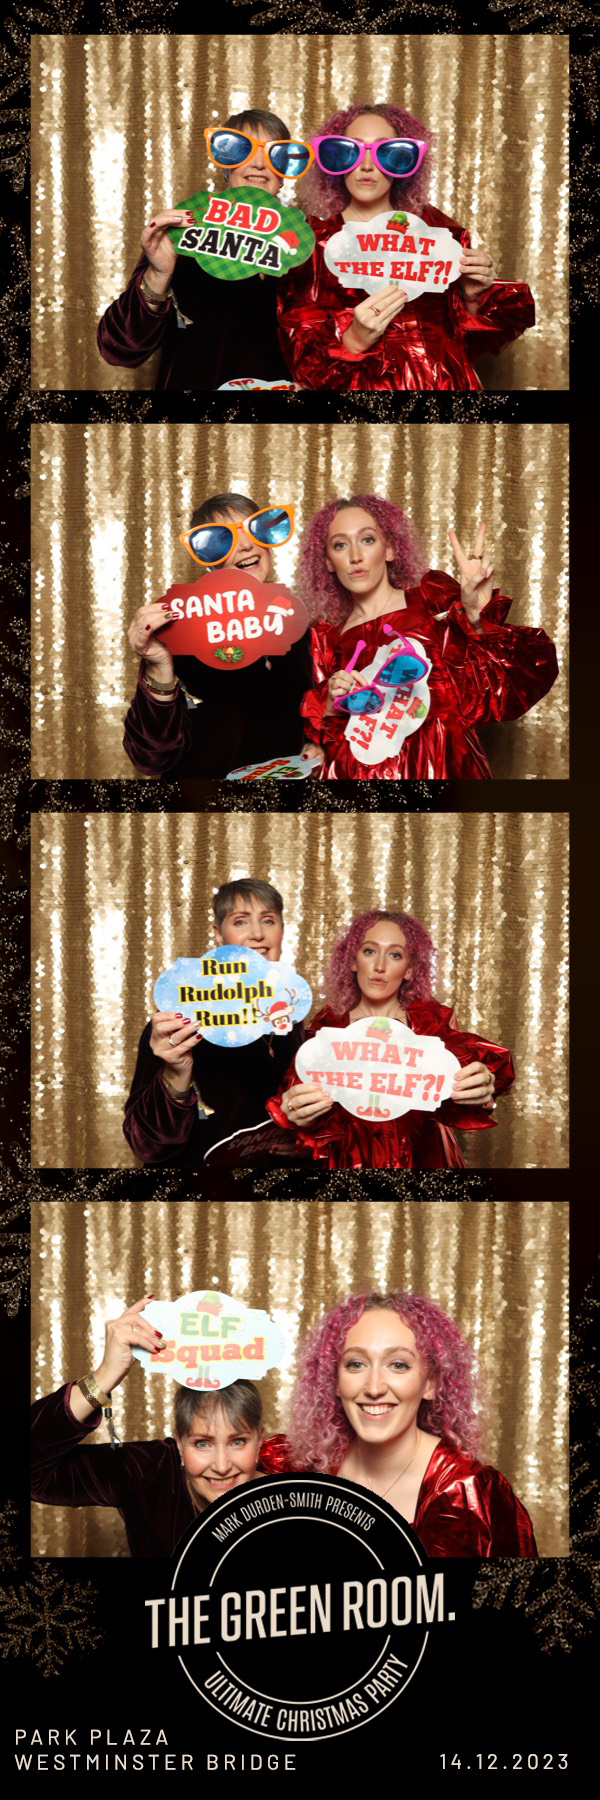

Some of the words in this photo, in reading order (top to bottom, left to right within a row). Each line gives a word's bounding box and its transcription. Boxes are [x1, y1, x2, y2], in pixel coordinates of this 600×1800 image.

[204, 198, 281, 234] BAD
[178, 227, 282, 270] SANTA
[356, 233, 436, 256] WHAT
[334, 261, 384, 277] THE
[389, 260, 453, 285] ELF?!
[170, 589, 255, 620] SANTA
[207, 613, 284, 643] BABY
[201, 958, 248, 976] Run
[178, 980, 275, 1004] Rudolph
[195, 1006, 258, 1027] Run!!
[331, 1041, 424, 1068] WHAT
[306, 1071, 363, 1089] THE
[369, 1072, 445, 1102] ELF?!
[180, 1312, 241, 1338] ELF
[150, 1336, 265, 1369] Squad
